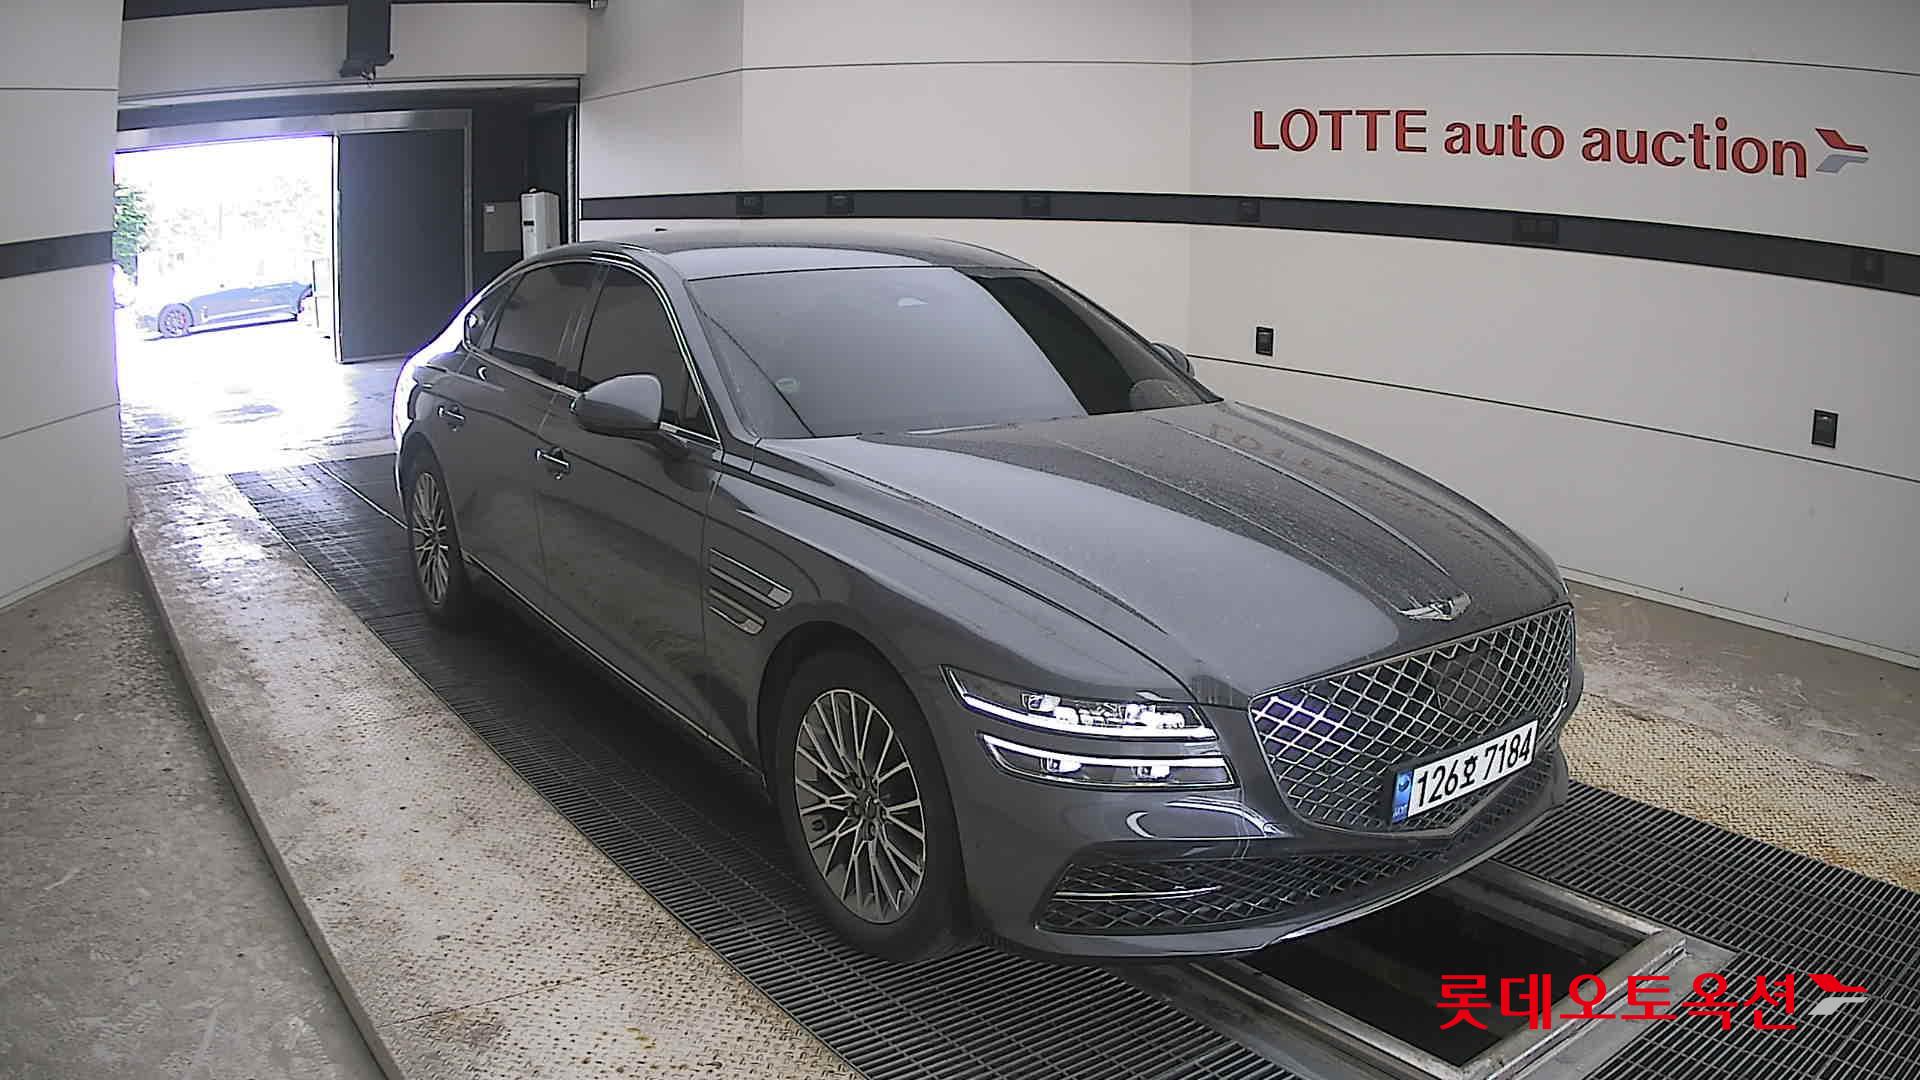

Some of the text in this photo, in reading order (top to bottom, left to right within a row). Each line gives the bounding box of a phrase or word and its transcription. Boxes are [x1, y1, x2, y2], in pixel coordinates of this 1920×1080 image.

[1253, 109, 1808, 179] LOTTE auto auction
[1483, 727, 1534, 781] 7184
